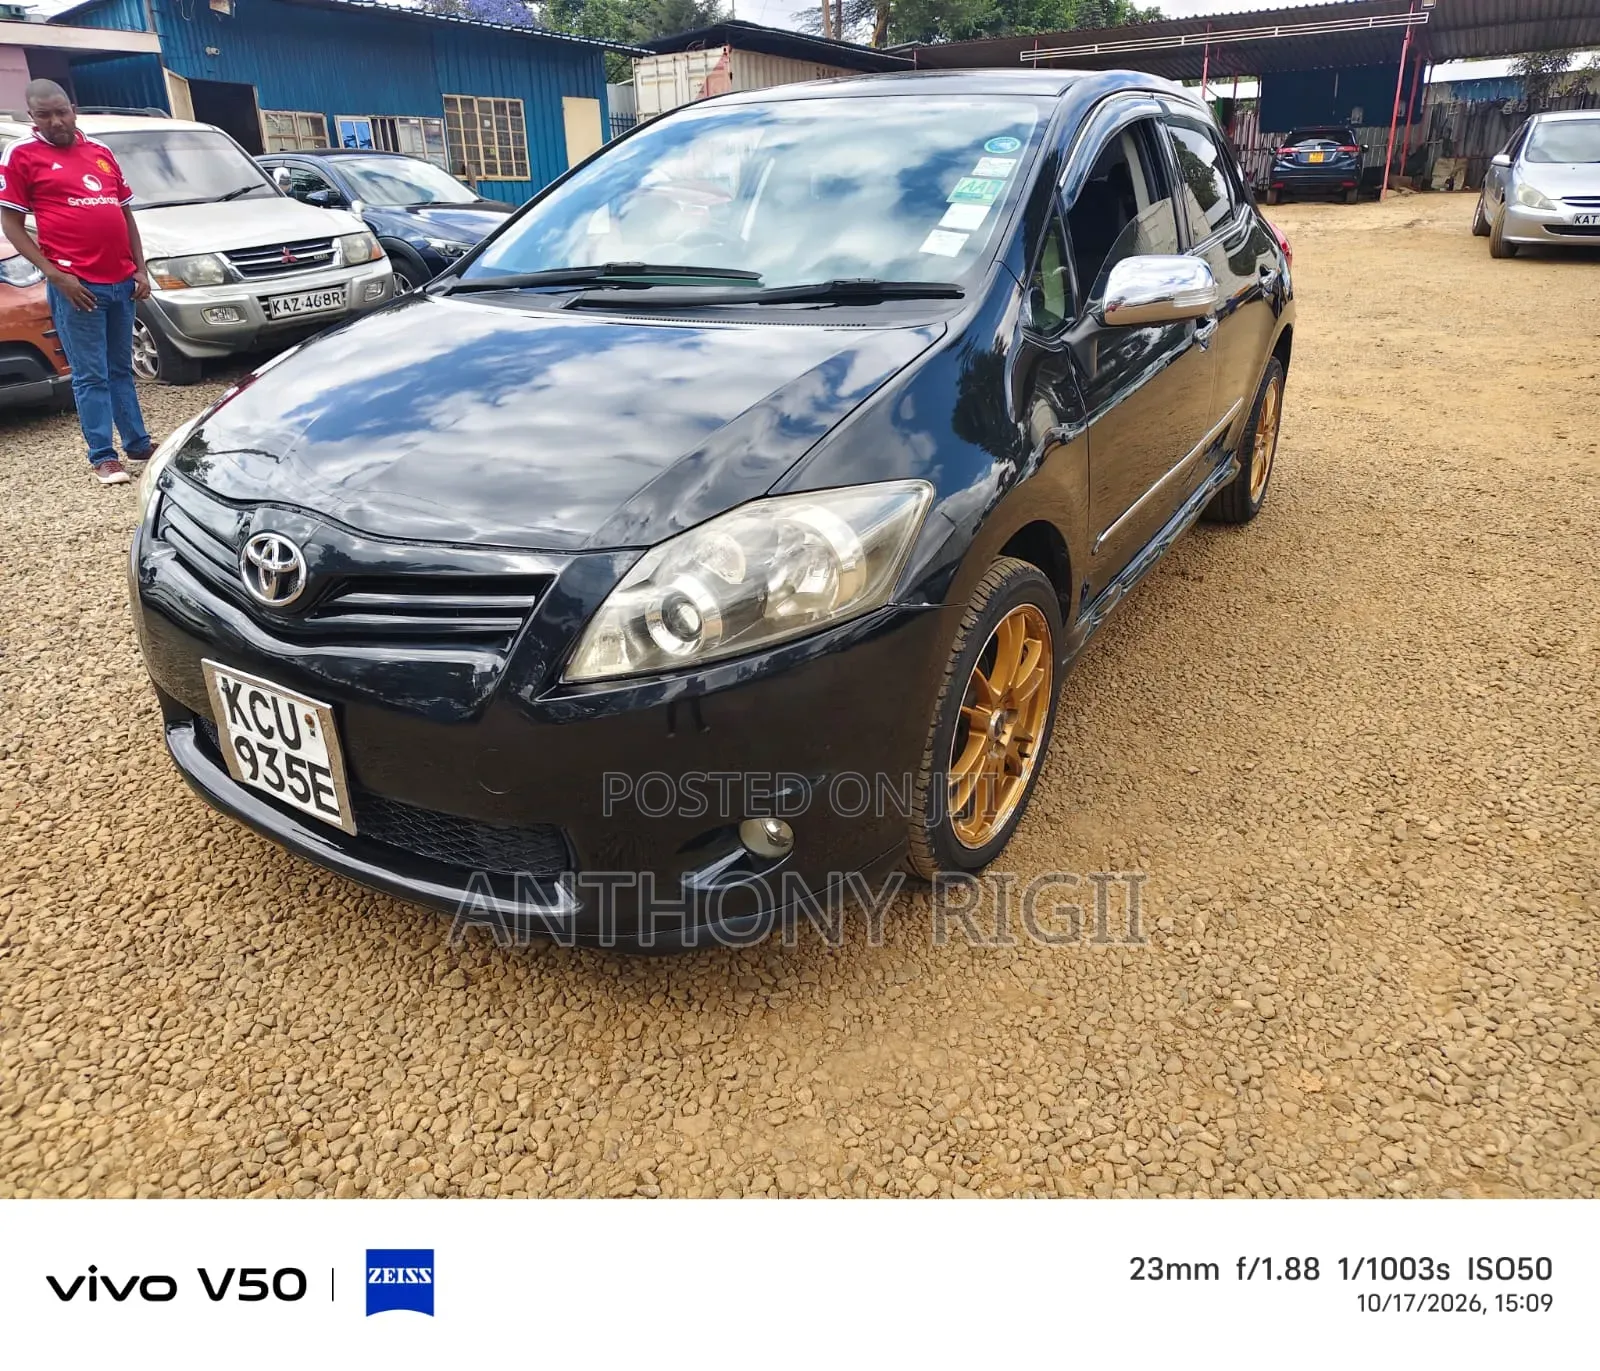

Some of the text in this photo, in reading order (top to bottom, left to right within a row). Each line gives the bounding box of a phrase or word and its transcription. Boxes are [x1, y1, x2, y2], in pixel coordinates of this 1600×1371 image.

[1574, 215, 1599, 225] KAT
[221, 677, 302, 750] KCU
[234, 735, 340, 817] 935E
